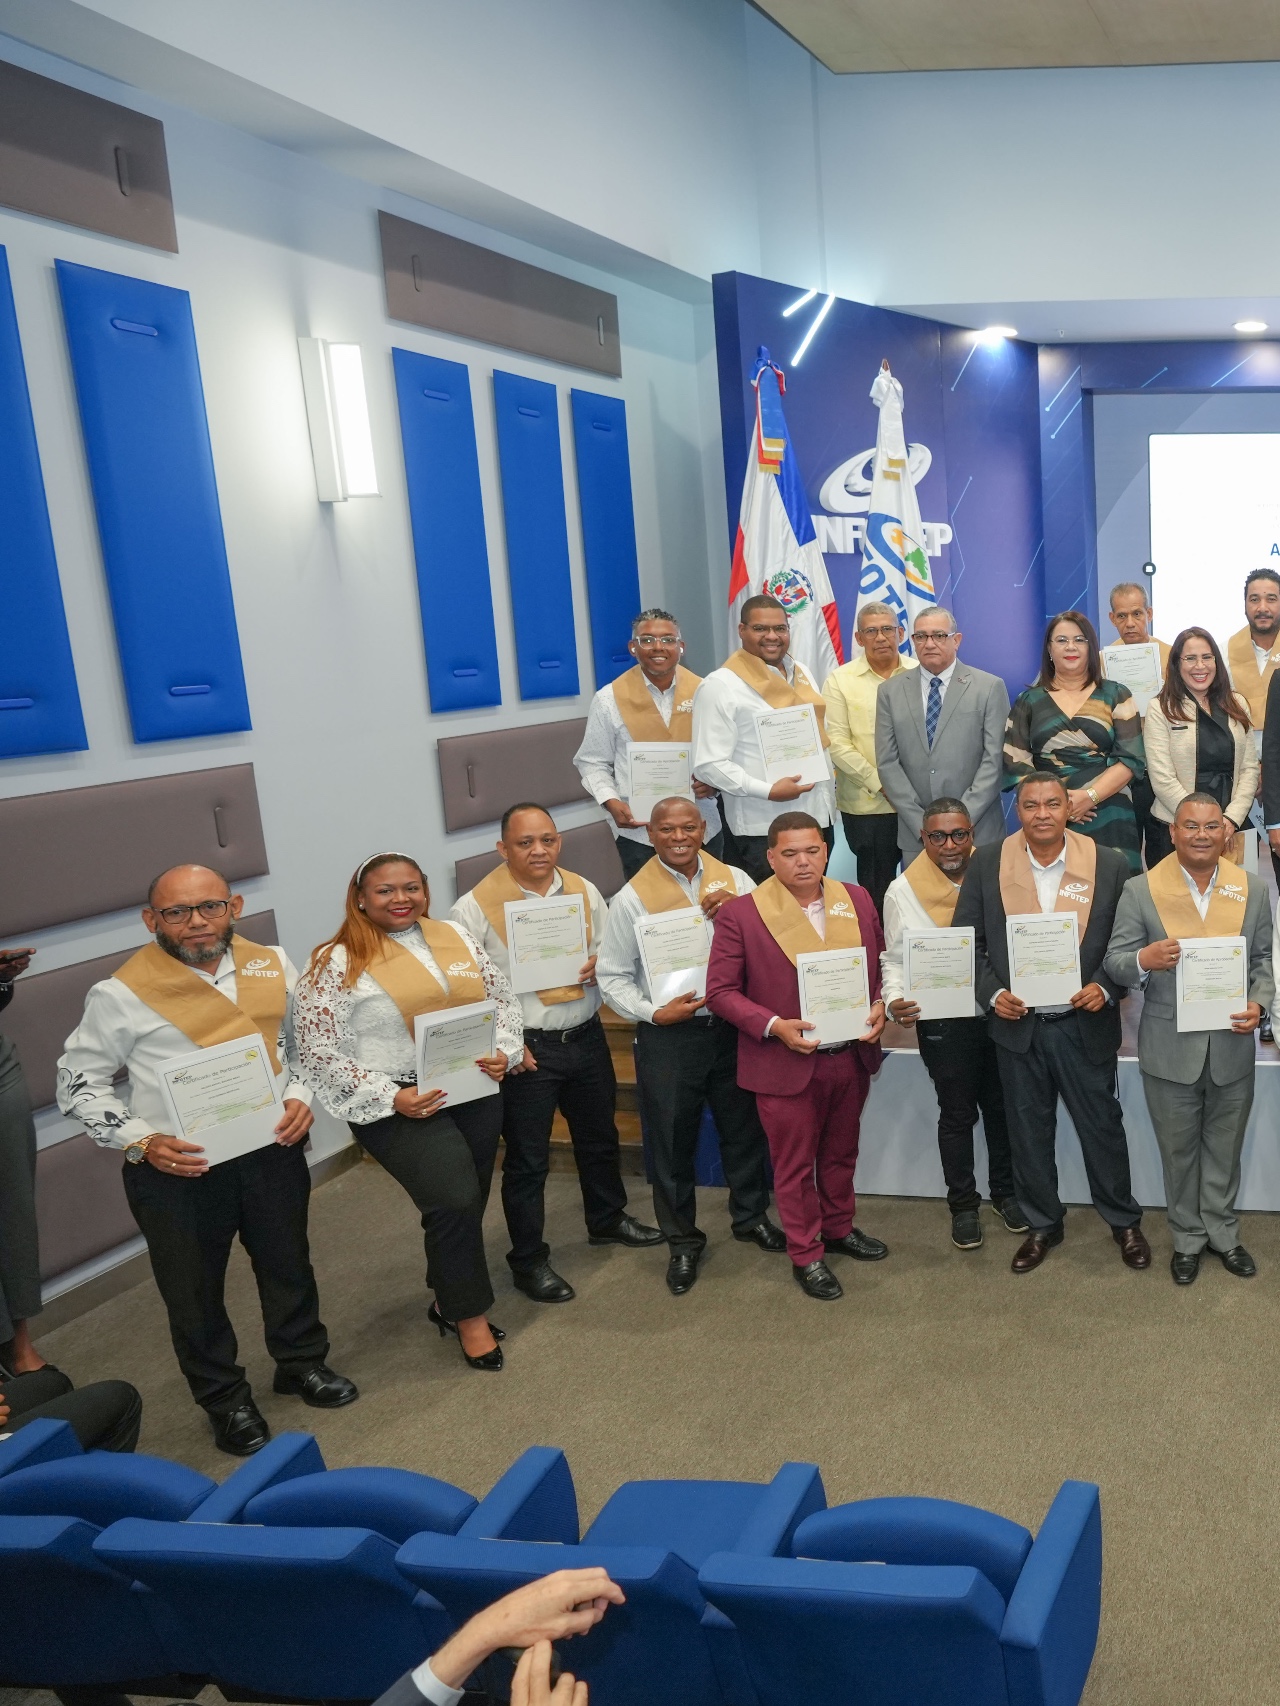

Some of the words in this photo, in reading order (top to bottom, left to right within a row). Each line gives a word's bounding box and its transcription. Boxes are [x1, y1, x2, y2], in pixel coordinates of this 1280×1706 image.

[676, 705, 692, 713] INFO
[1059, 889, 1090, 904] INFOTEP
[1219, 887, 1246, 902] INFOTEP
[829, 909, 855, 919] INFOTEP
[242, 968, 279, 978] INFOTEP
[447, 969, 480, 979] INFOTEP
[183, 1073, 212, 1085] Certificado
[220, 1062, 252, 1074] Participación
